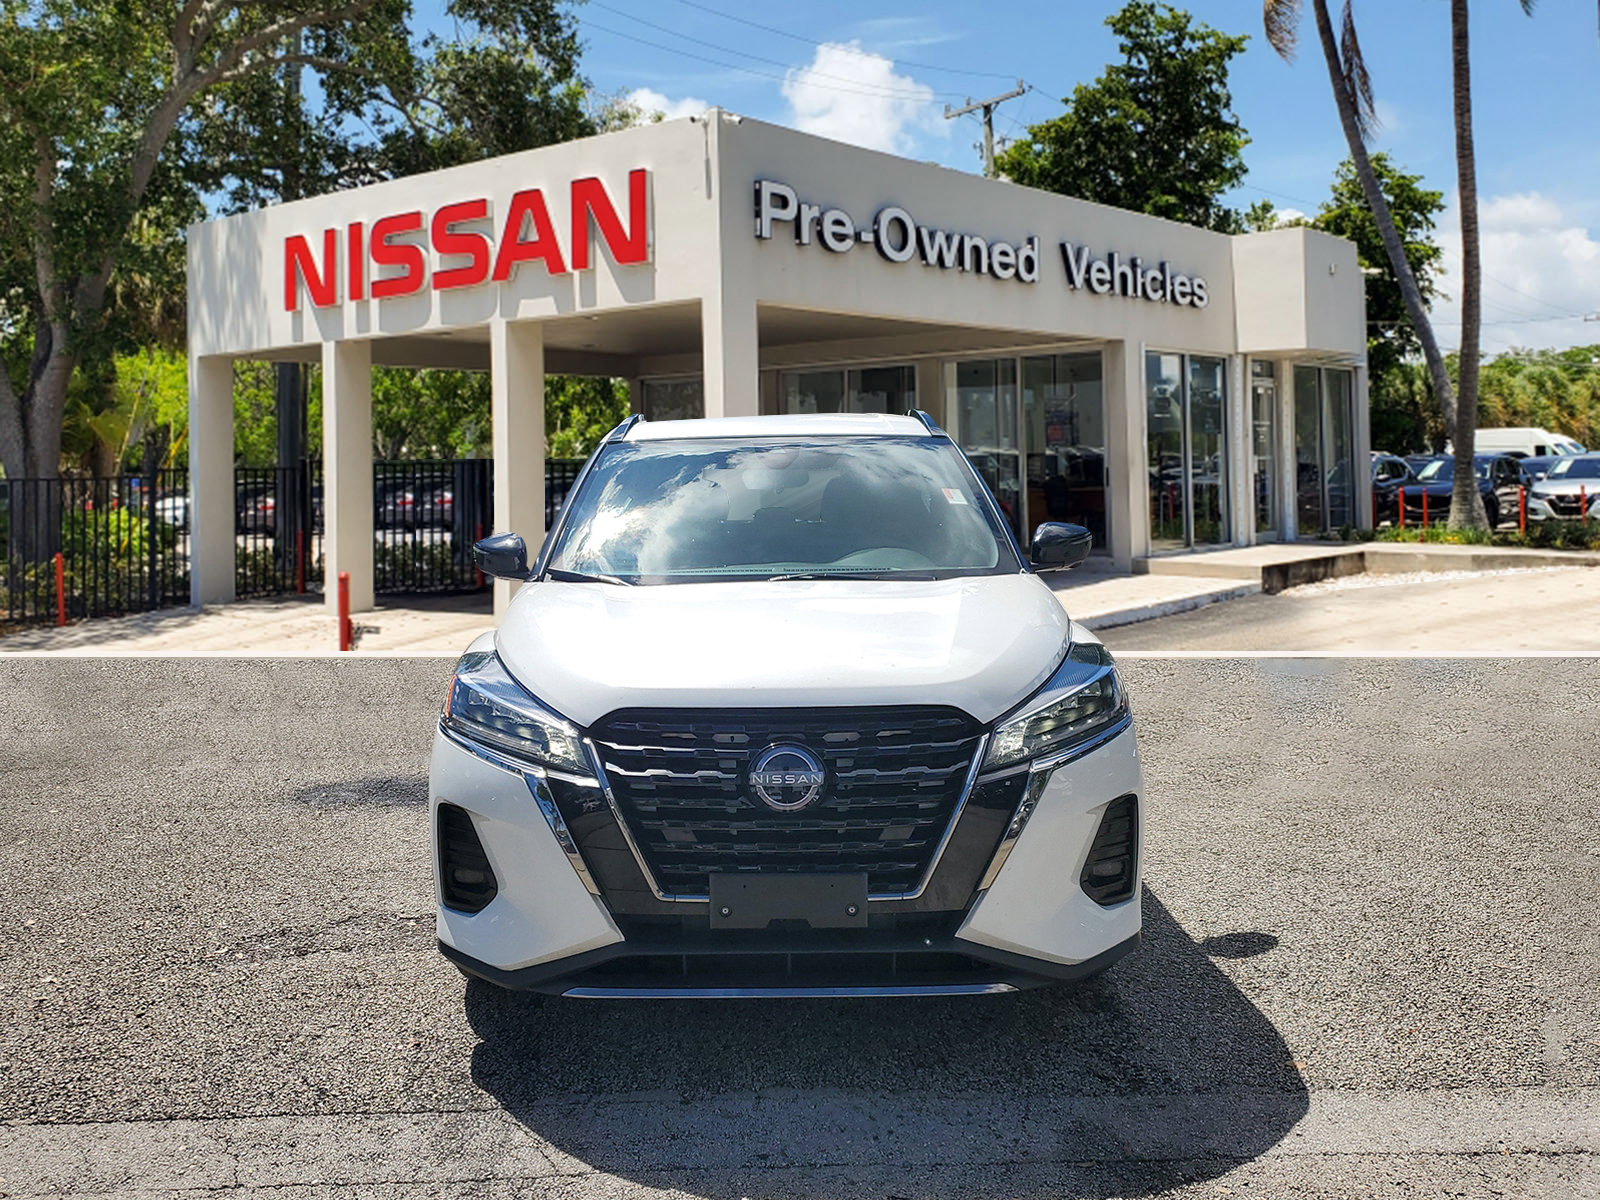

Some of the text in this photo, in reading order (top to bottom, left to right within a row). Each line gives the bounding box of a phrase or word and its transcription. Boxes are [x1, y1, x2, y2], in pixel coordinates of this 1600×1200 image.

[285, 169, 647, 312] NISSAN
[754, 180, 1209, 309] Pre-Owned Vehicles
[752, 774, 823, 784] NISSAN
